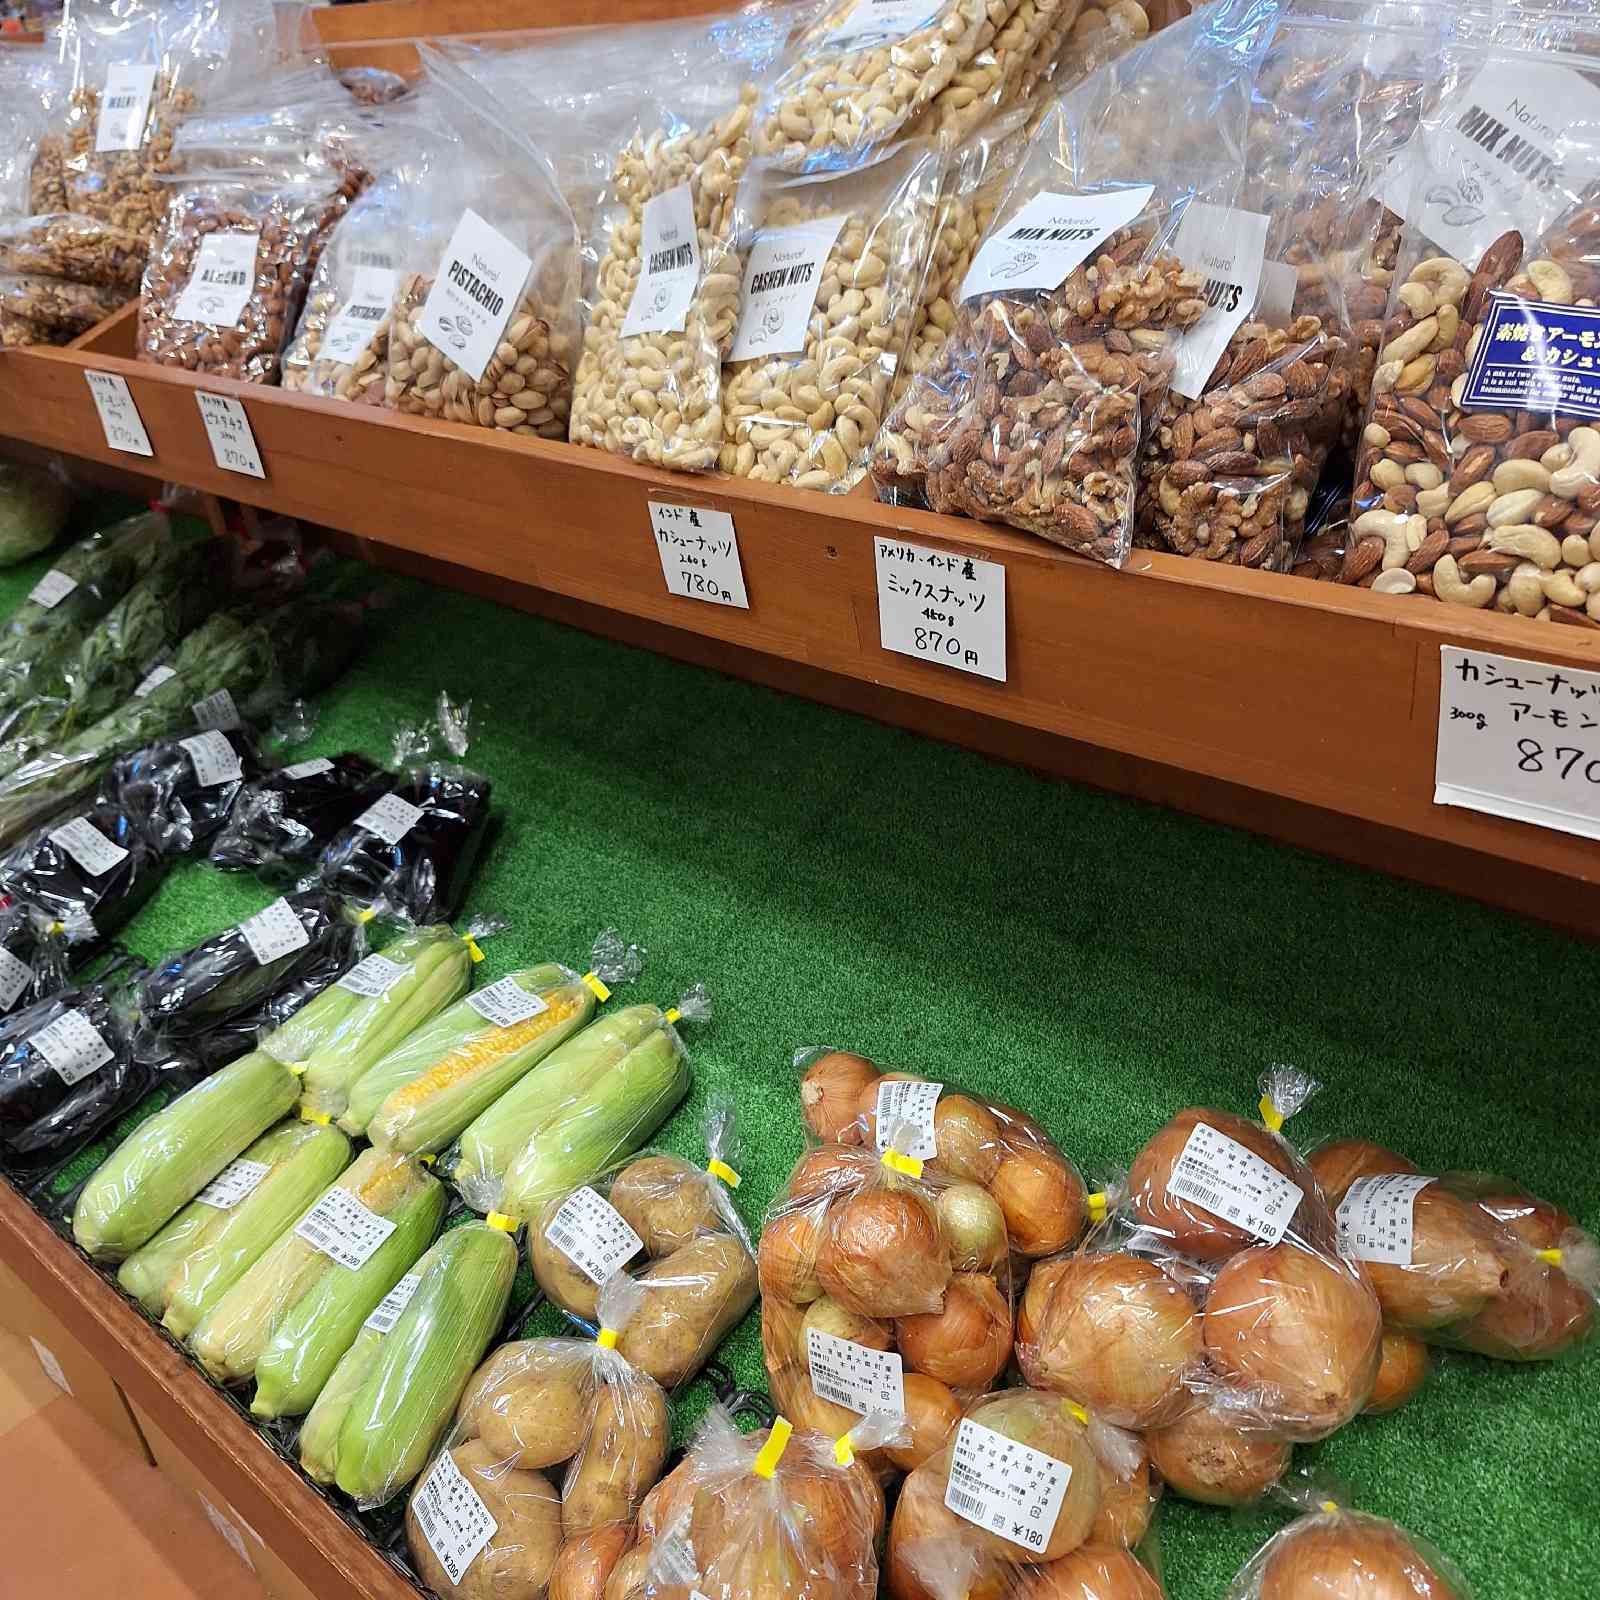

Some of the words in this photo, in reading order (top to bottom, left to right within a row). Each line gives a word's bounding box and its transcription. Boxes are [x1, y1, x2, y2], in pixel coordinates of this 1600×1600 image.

[1456, 104, 1509, 152] MIX
[1496, 134, 1565, 193] NUTS
[1008, 227, 1050, 240] MIX
[1044, 227, 1101, 241] NUTS
[649, 248, 676, 275] CASHEW
[676, 242, 694, 268] NUTS
[448, 259, 504, 317] PISTACHIO
[750, 267, 790, 295] CASHEW
[787, 262, 815, 286] NUTS
[888, 573, 985, 613] ミックスナッツ
[1450, 706, 1488, 730] 300g
[1246, 1214, 1277, 1237] ¥180
[583, 1258, 607, 1281] ¥200
[1012, 1521, 1043, 1546] ¥180
[442, 1551, 459, 1579] ¥200
